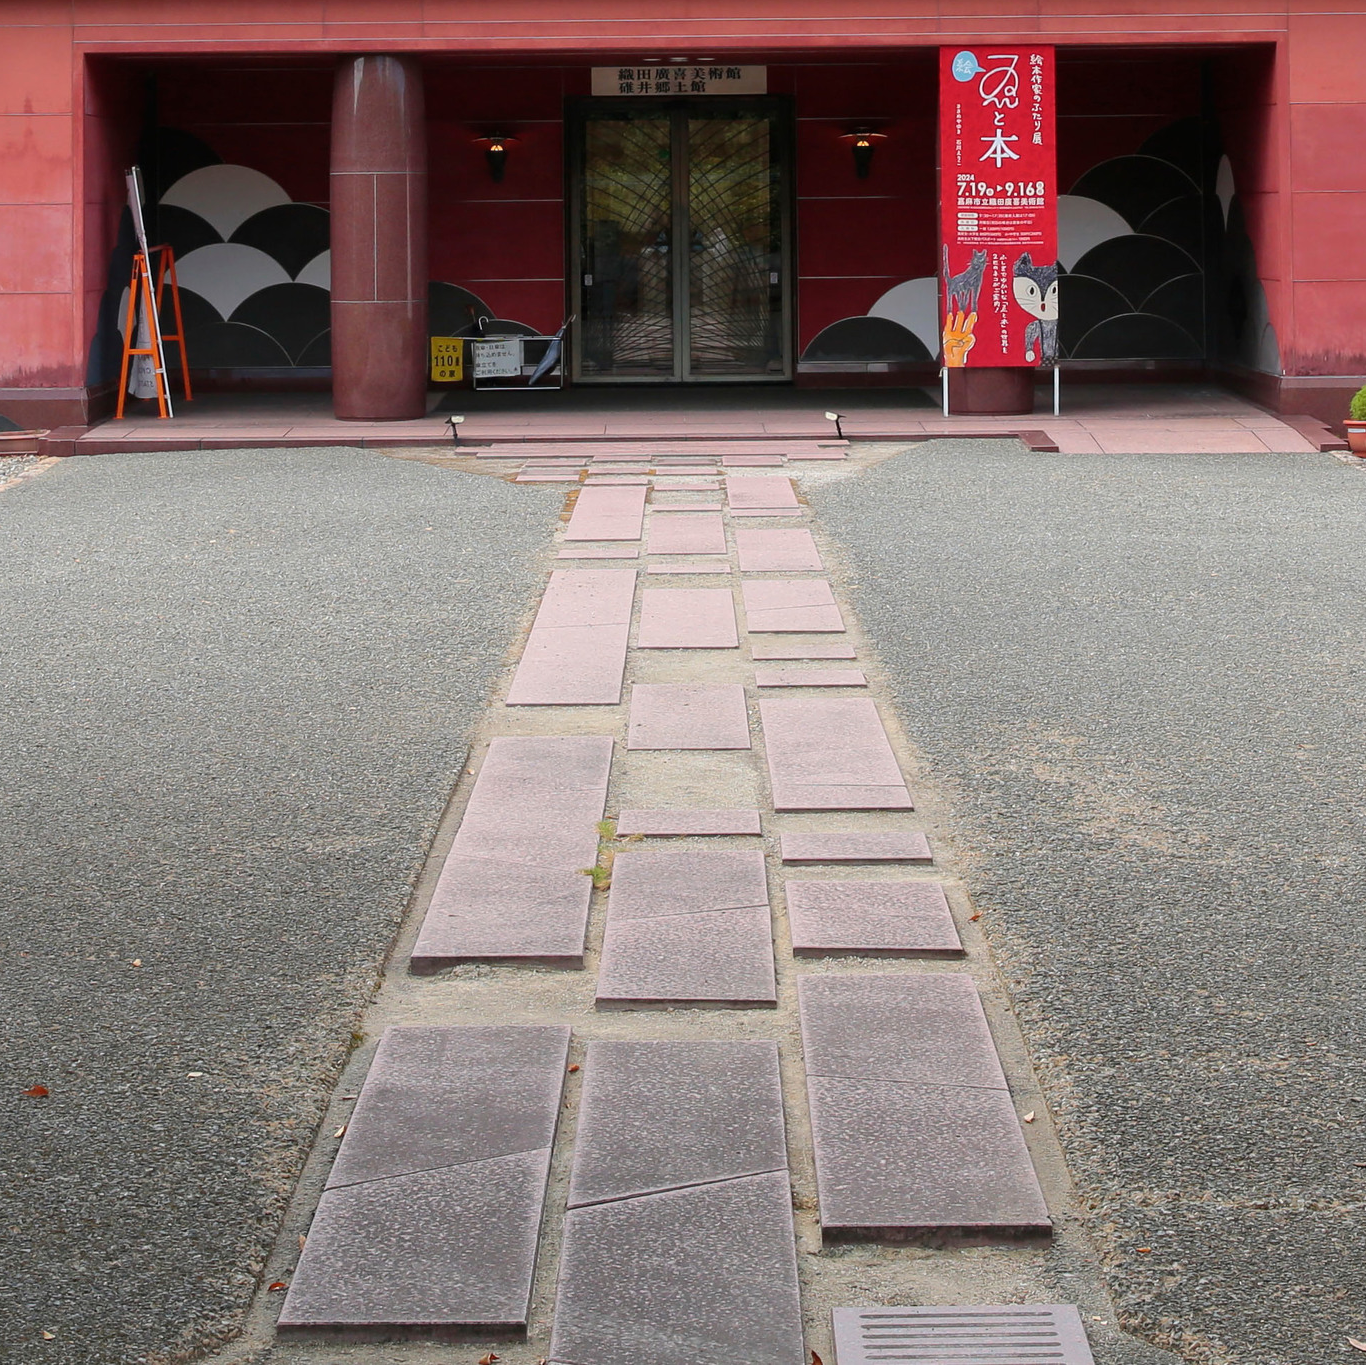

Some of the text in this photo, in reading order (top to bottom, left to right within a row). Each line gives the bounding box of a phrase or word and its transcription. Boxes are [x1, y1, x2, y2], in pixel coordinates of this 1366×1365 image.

[955, 58, 974, 74] 絵
[618, 67, 742, 81] 織田廣喜美術館
[618, 81, 706, 94] 碓井郷土館
[1029, 53, 1044, 146] 絵本作家のふたり展
[438, 345, 458, 353] こども
